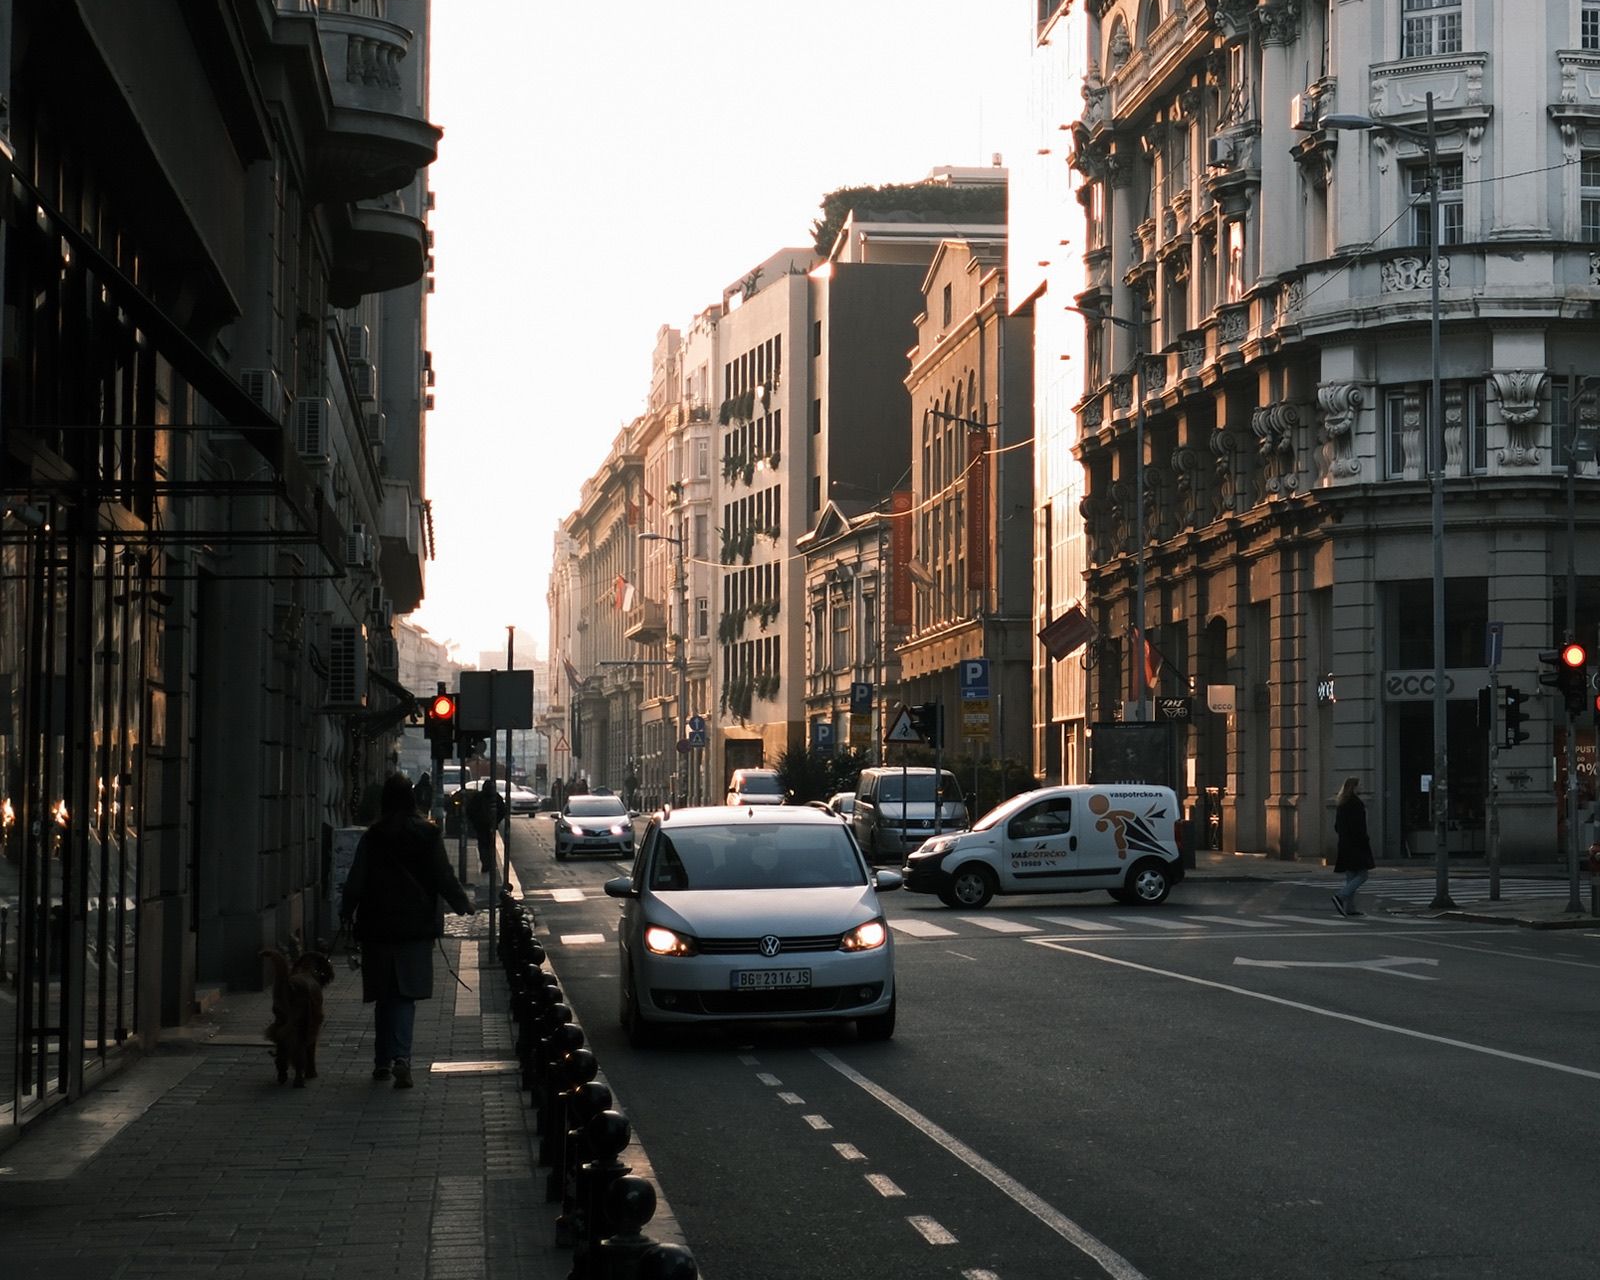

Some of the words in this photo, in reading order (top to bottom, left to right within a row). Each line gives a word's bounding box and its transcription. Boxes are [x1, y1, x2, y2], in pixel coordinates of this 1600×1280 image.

[966, 663, 983, 685] P
[855, 685, 868, 702] P
[818, 725, 830, 742] P
[1563, 745, 1597, 754] PPUST
[740, 973, 755, 986] BG
